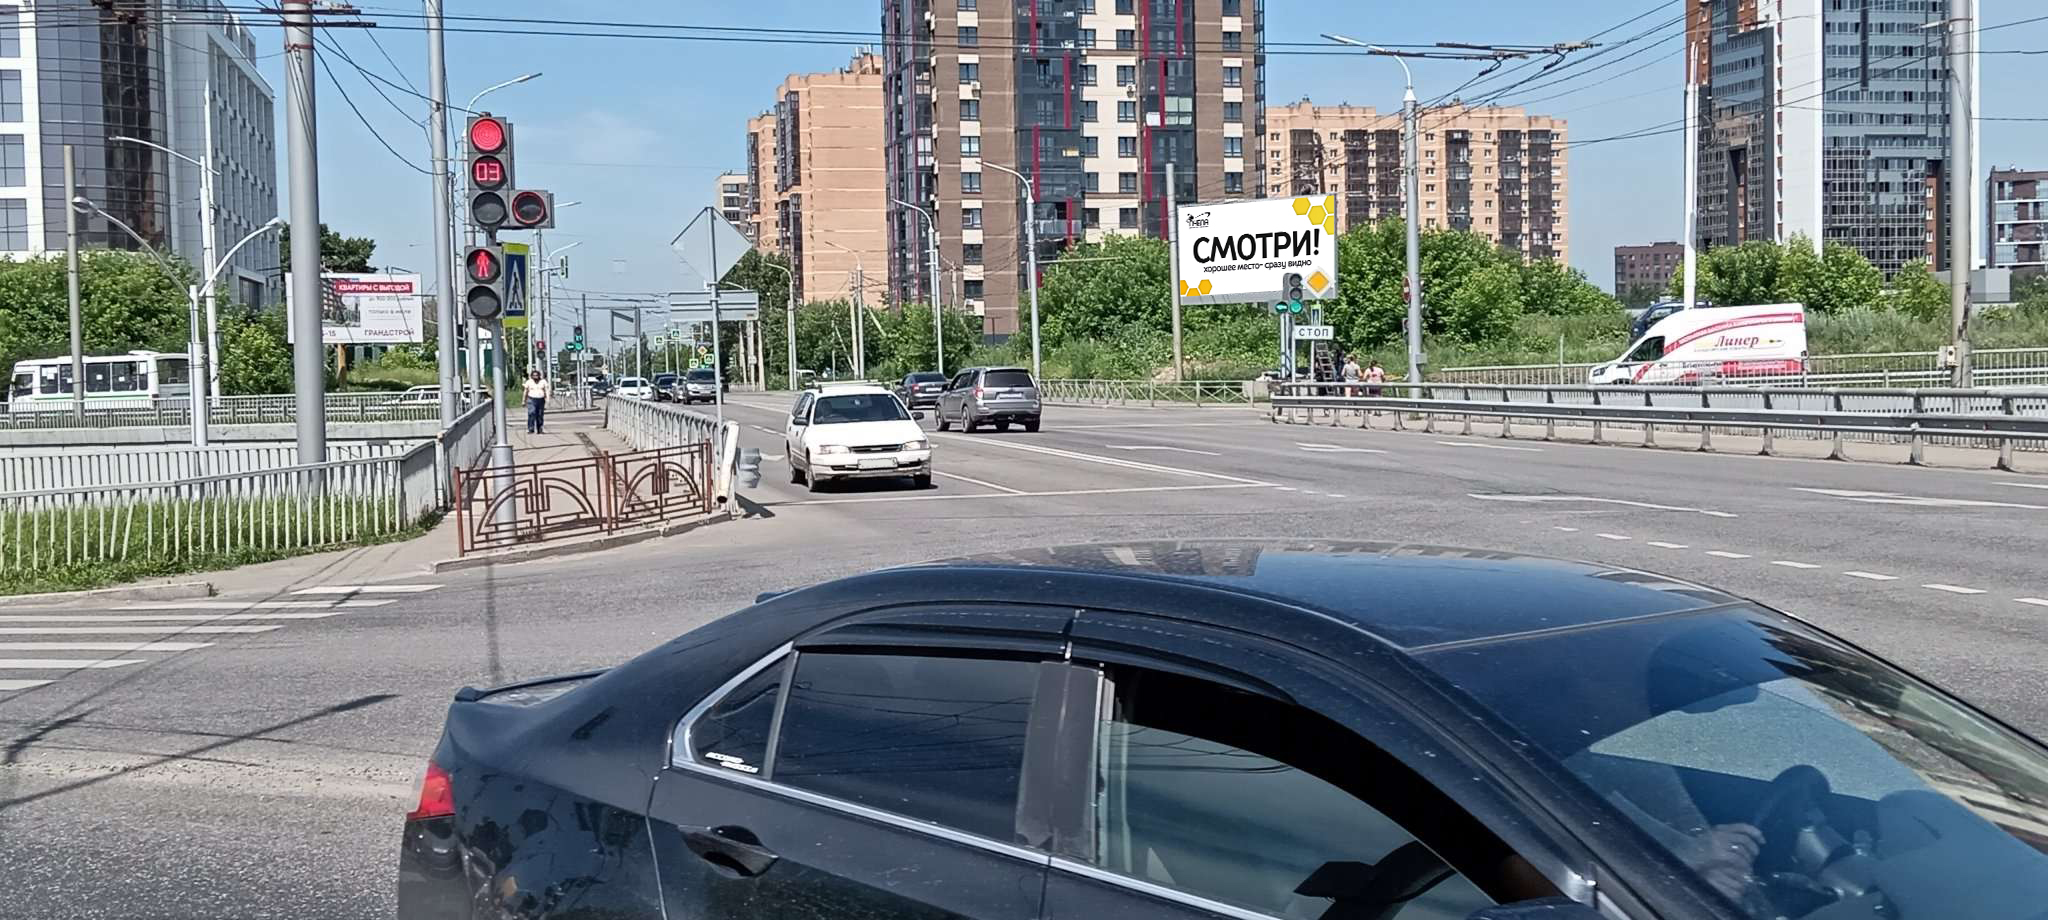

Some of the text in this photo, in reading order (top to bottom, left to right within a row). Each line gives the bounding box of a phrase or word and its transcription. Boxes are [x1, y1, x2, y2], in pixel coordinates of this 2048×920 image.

[476, 163, 500, 181] 03
[1193, 228, 1320, 264] СМОТРИ!
[1203, 266, 1236, 274] хорошее
[1264, 261, 1287, 270] сразу
[1288, 260, 1312, 268] видно
[338, 283, 372, 291] КВАРТИРЫ
[373, 283, 379, 291] С
[364, 327, 414, 337] ГРАНДСТРОЙ
[1298, 328, 1329, 337] СТОП
